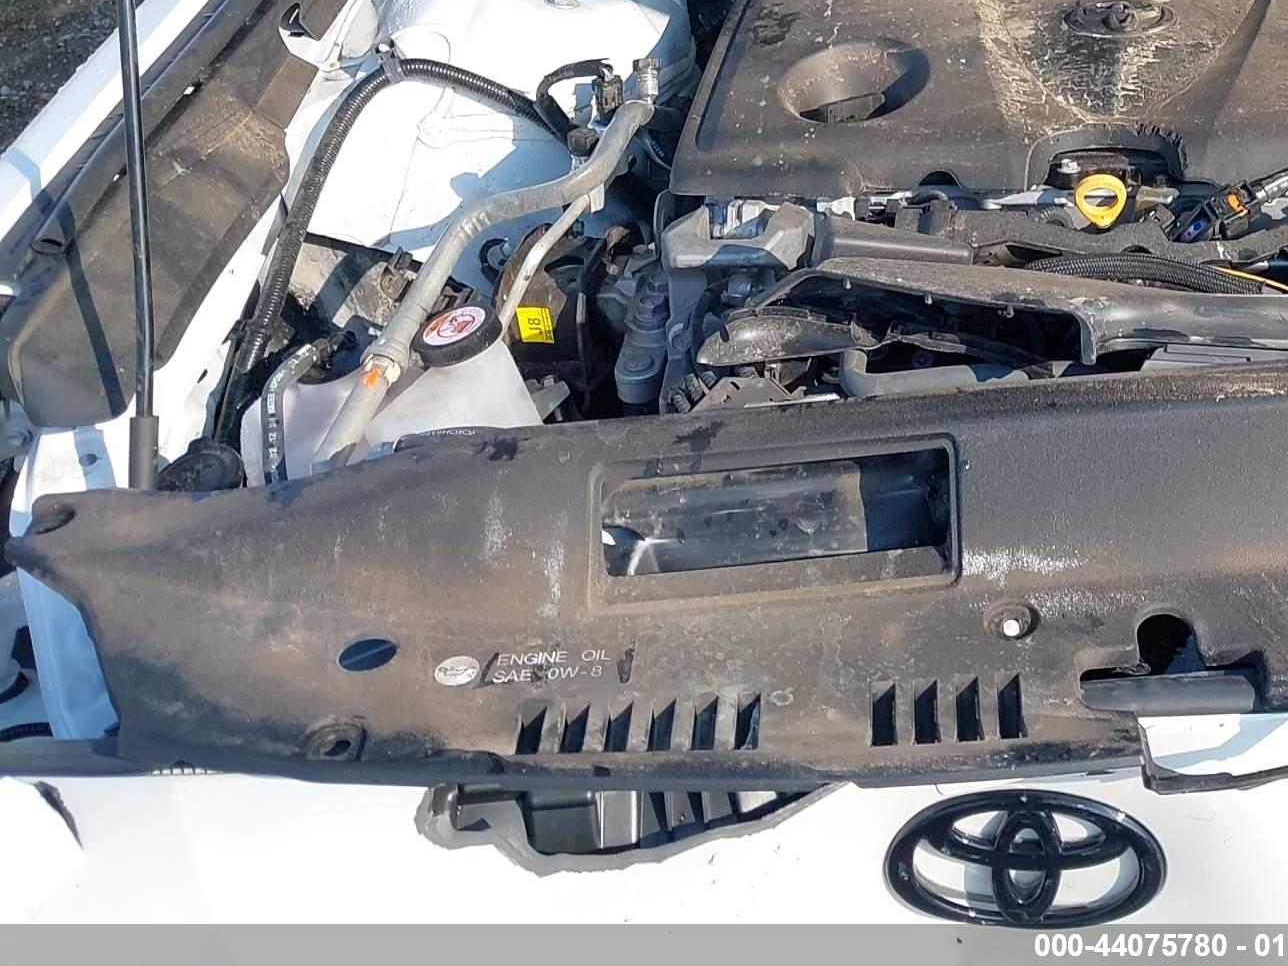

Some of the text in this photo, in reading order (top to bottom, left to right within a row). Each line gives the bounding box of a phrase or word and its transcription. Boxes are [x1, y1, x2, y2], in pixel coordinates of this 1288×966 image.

[497, 649, 611, 666] ENGINE OIL
[492, 669, 532, 683] SAE
